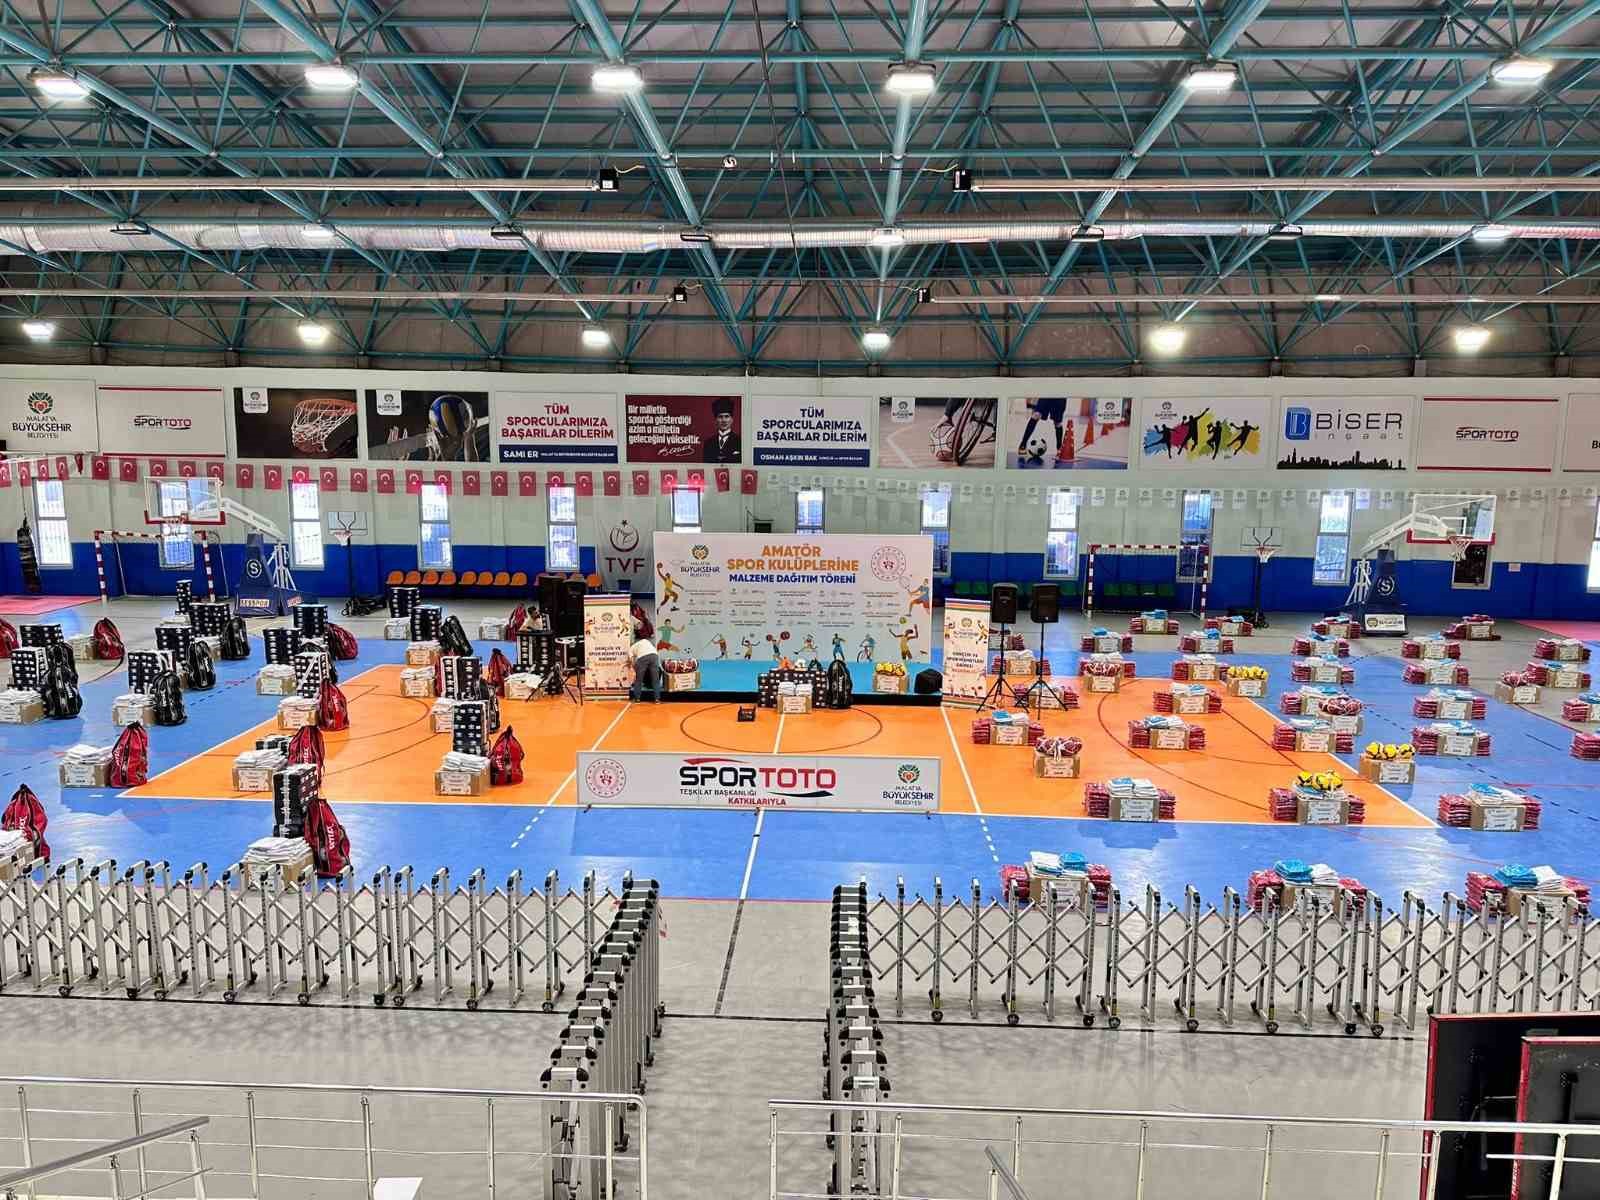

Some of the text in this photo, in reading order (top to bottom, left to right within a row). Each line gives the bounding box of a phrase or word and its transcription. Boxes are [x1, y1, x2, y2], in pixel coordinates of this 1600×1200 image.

[544, 403, 570, 415] TÜM
[800, 406, 825, 418] TÜM
[134, 418, 191, 427] SPORTOTO
[506, 416, 608, 427] SPORCULARIMIZA
[762, 419, 862, 431] SPORCULARIMIZA
[501, 428, 614, 440] BAŞARILAR DİLERİM
[756, 430, 867, 444] BAŞARILAR DİLERİM
[1455, 430, 1519, 440] SPORTOTO
[527, 450, 539, 459] ER
[760, 453, 785, 461] OSMAN
[761, 543, 823, 558] AMATÖR
[249, 562, 259, 574] S
[604, 557, 646, 574] TVF
[727, 556, 860, 572] SPOR KULÜPLERİNE
[729, 572, 857, 585] MALZEME DAĞITIM TÖRENİ
[679, 766, 837, 789] SPORTOTO
[728, 796, 787, 806] KATKILARIYLA
